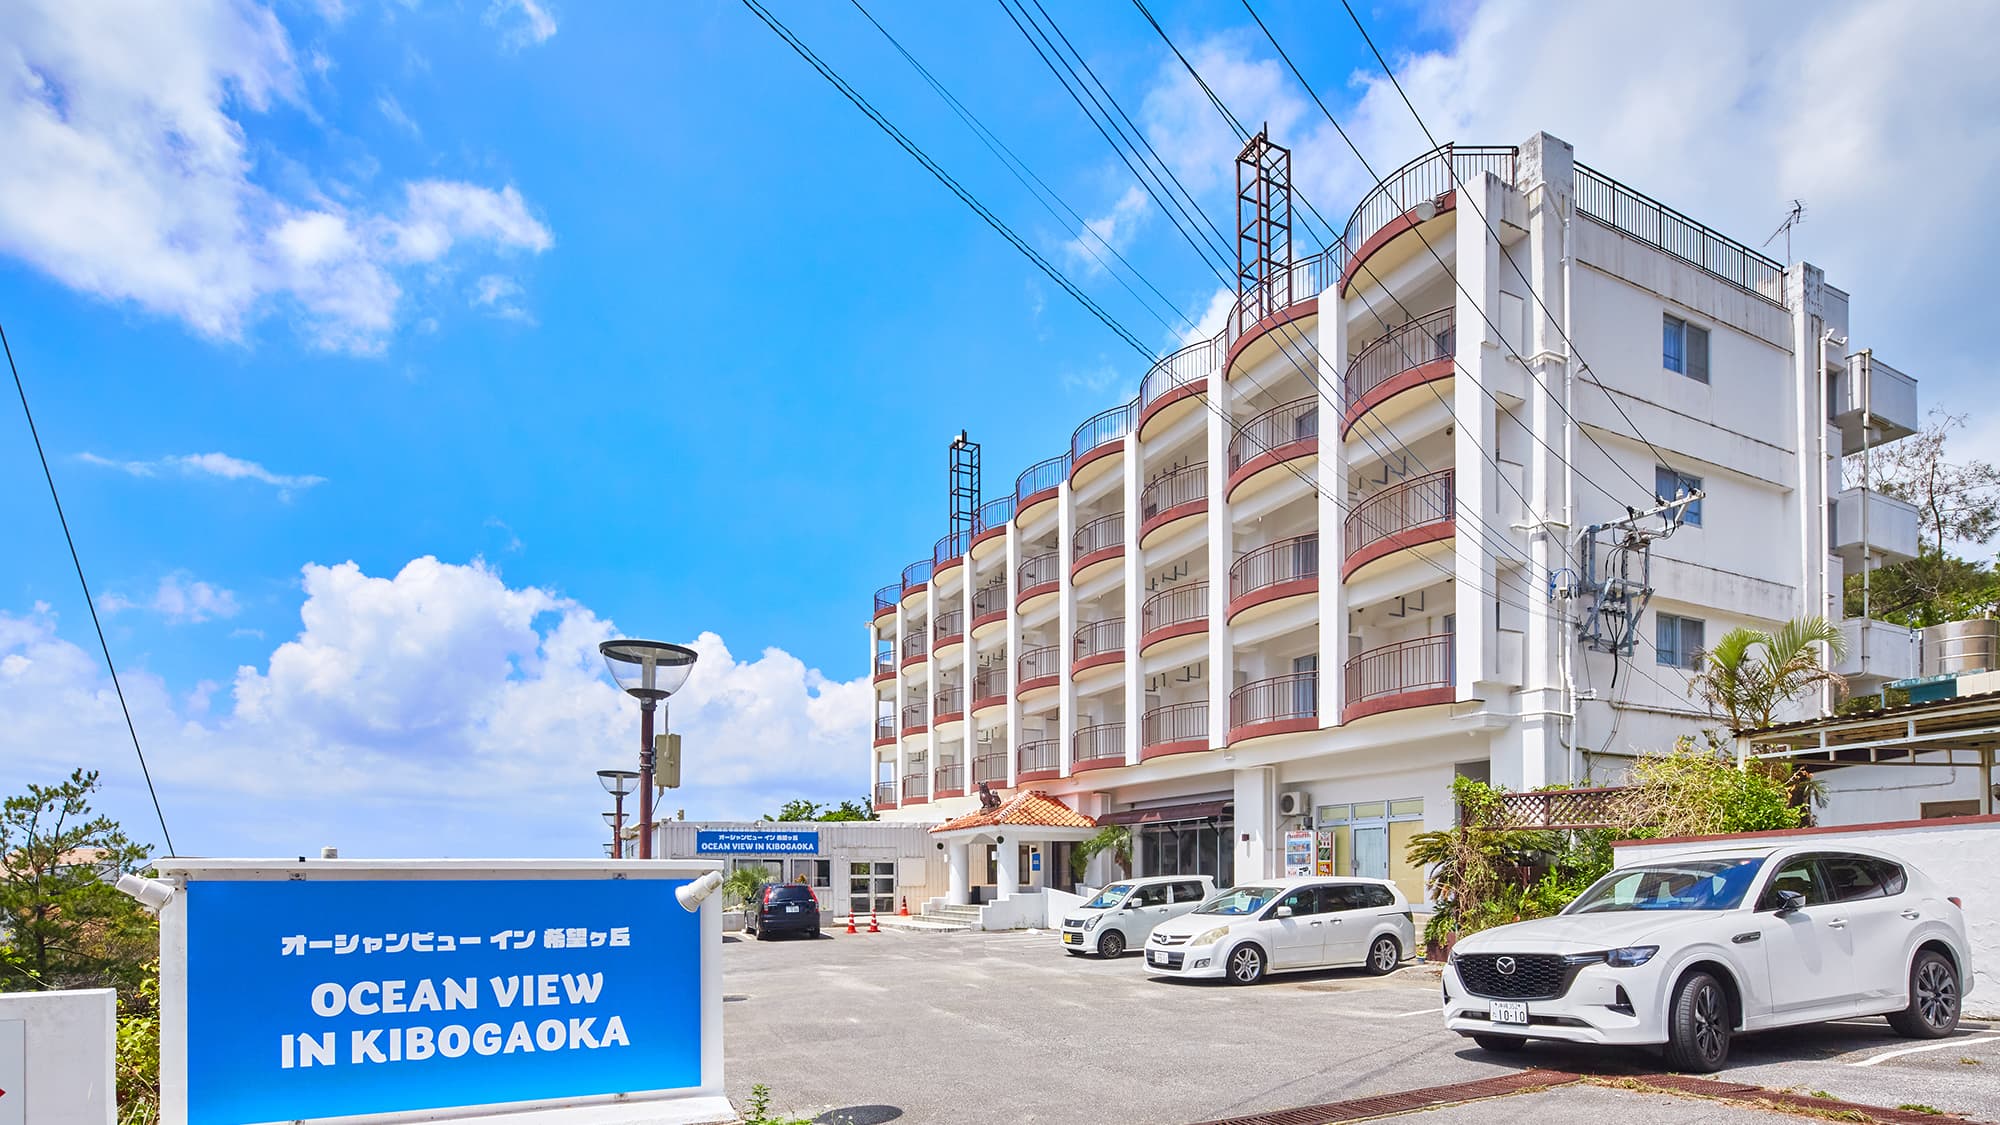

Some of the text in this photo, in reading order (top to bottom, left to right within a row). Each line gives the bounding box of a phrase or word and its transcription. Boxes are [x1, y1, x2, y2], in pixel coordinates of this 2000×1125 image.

[701, 842, 815, 850] OCEAN VIEW IN KIBOGAOKA
[281, 926, 630, 956] オーシャンビュー イン 希望ヶ丘
[311, 972, 604, 1017] OCEAN VIEW
[281, 1015, 630, 1069] IN KIBOGAOKA
